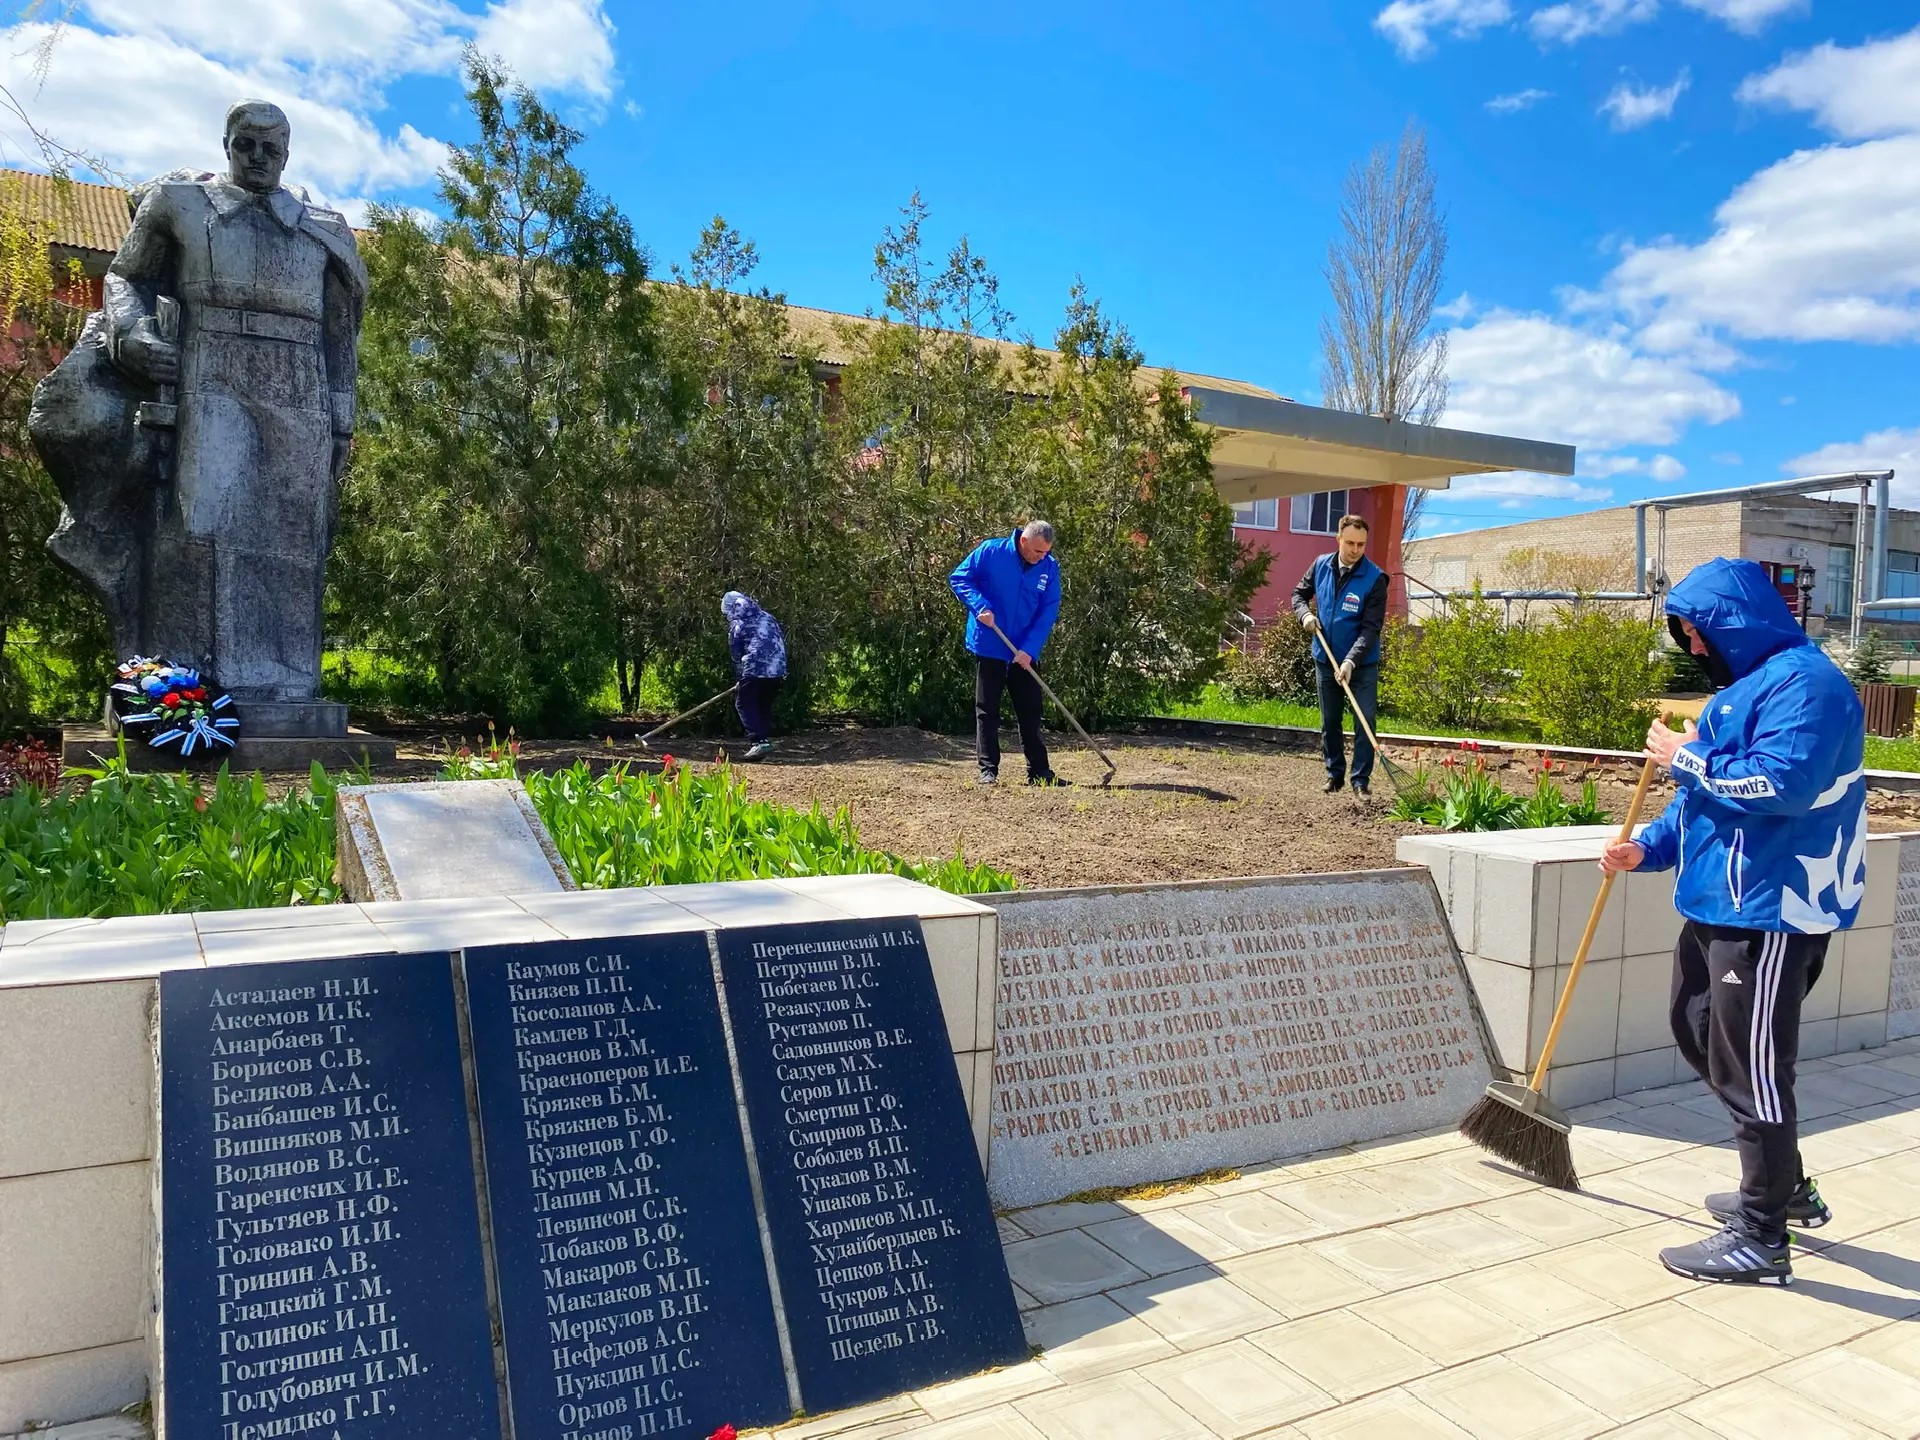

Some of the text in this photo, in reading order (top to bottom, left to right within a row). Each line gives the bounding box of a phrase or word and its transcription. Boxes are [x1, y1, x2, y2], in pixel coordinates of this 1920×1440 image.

[752, 930, 919, 960] Перепелинский И.К.
[506, 955, 630, 982] Каумов С.И.
[756, 953, 881, 978] Петрунин В.И.
[760, 972, 879, 998] Побегаев И.С.
[209, 977, 379, 1007] Астадаев Н.И.
[508, 976, 632, 1002] Князев П.П.
[764, 993, 872, 1019] Резакулов А.
[1107, 990, 1181, 1017] НИКЛЯЕВ
[209, 1001, 371, 1031] Аксемов И.К.
[511, 995, 662, 1024] Косолапов А.А.
[768, 1013, 872, 1042] Рустамов П.
[1163, 1011, 1223, 1035] ОСИПОВ
[1272, 999, 1329, 1021] ПЕТРОВ
[210, 1025, 354, 1056] Анарбаев Т.
[514, 1018, 635, 1047] Камлев Г.Д.
[772, 1028, 912, 1061] Садовников В.Е.
[212, 1048, 371, 1082] Борисов С.В.
[517, 1038, 655, 1072] Краснов В.М.
[776, 1053, 883, 1082] Садуев М.Х.
[995, 1053, 1086, 1085] ПЯТЫШКИН
[1132, 1037, 1209, 1065] ПАХОМОВ
[213, 1072, 371, 1107] Беляков А.А.
[519, 1055, 698, 1095] Красноперов И.Е.
[781, 1075, 878, 1104] Серов И.Н.
[213, 1093, 397, 1132] Банбашев И.С.
[522, 1082, 656, 1119] Кряжев Б.М.
[785, 1093, 903, 1126] Смертин Г.Ф.
[1001, 1080, 1081, 1112] ПАЛАТОВ
[1006, 1108, 1081, 1139] РЫЖКОВ
[1088, 1102, 1124, 1126] С.М
[1144, 1088, 1212, 1117] СТРОКОВ
[1398, 1052, 1441, 1075] СЕРОВ
[213, 1116, 409, 1159] Вишняков М.И.
[525, 1104, 672, 1142] Кряжнев Б.М.
[789, 1115, 907, 1148] Смирнов В.А.
[1067, 1124, 1152, 1158] СЕНЯКИН
[1205, 1103, 1281, 1133] СМИРНОВ
[1331, 1083, 1406, 1111] СОЛОВЬЕВ
[214, 1145, 379, 1185] Водянов В.С.
[528, 1127, 675, 1166] Кузнецов Г.Ф.
[794, 1136, 909, 1170] Соболев Я.П.
[215, 1167, 409, 1213] Гаренских И.Е.
[531, 1151, 661, 1190] Курцев А.Ф.
[796, 1157, 916, 1196] Тукалов В.М.
[534, 1177, 659, 1212] Лапин М.Н.
[801, 1180, 913, 1216] Ушаков Б.Е.
[216, 1194, 398, 1243] Гультяев Н.Ф.
[536, 1196, 687, 1238] Левинсон С.К.
[806, 1198, 943, 1240] Хармисов М.П.
[216, 1220, 401, 1268] Головако И.И.
[539, 1223, 684, 1264] Лобаков В.Ф.
[810, 1219, 961, 1265] Худайбердыев К.
[218, 1251, 376, 1299] Гринин А.В.
[543, 1246, 688, 1289] Макаров С.В.
[816, 1249, 929, 1289] Цепков Н.А.
[218, 1275, 392, 1325] Гладкий Г.М.
[546, 1267, 709, 1315] Маклаков М.П.
[820, 1271, 933, 1313] Чукров А.И.
[219, 1302, 396, 1355] Голинок И.Н.
[549, 1294, 708, 1344] Меркулов В.Н.
[825, 1294, 944, 1335] Птицын А.В.
[906, 1319, 945, 1343] Г.В.
[220, 1327, 409, 1385] Голтяпин А.П.
[552, 1321, 699, 1370] Нефедов А.С.
[220, 1353, 428, 1416] Голубович И.М.
[555, 1349, 700, 1400] Нуждин И.С.
[558, 1379, 683, 1429] Орлов Н.С.
[639, 1405, 692, 1436] П.Н.
